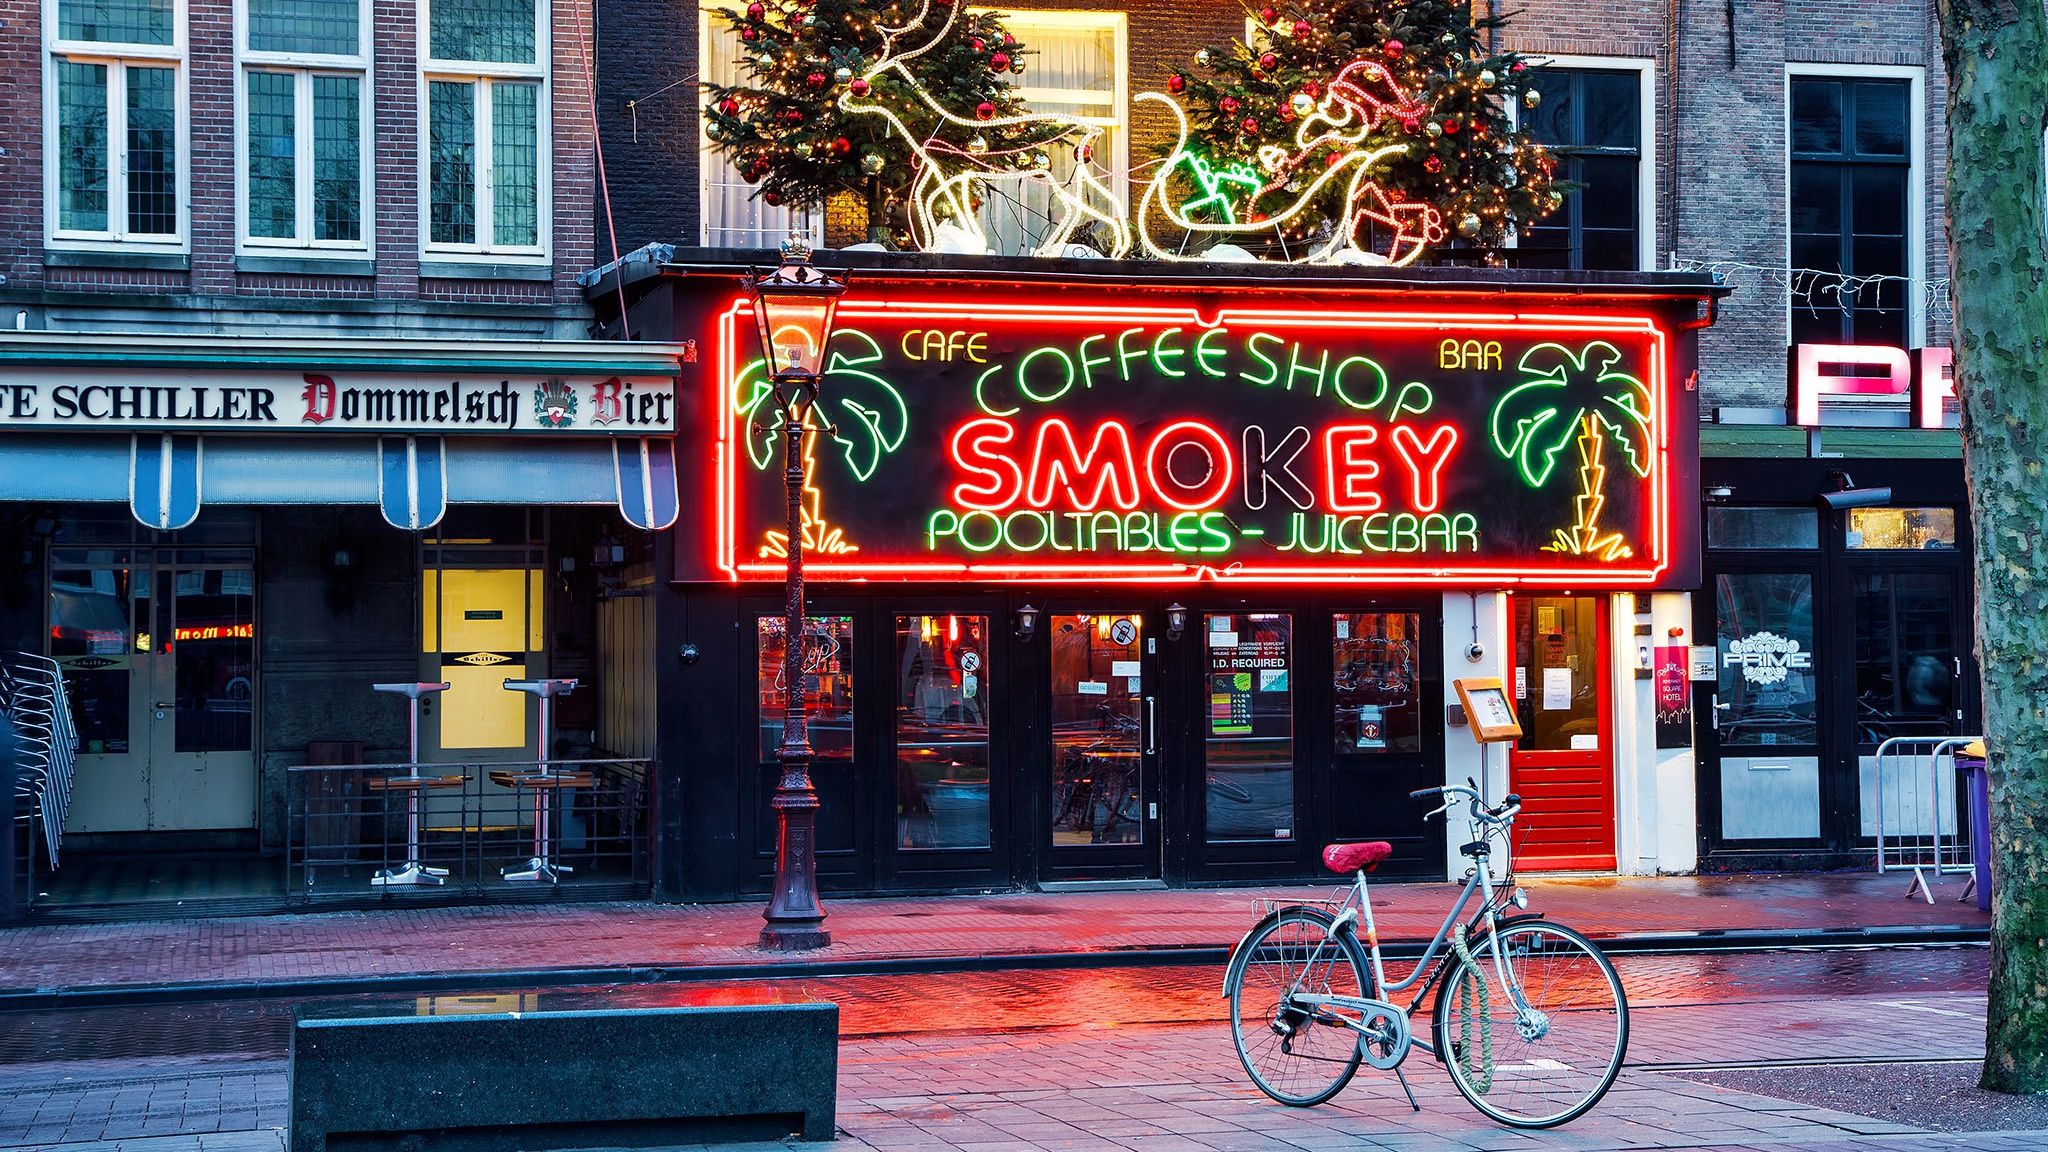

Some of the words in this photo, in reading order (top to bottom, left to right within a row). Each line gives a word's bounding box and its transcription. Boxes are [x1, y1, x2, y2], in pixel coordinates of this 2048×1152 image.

[902, 329, 988, 364] CAFE
[1439, 338, 1504, 371] BAR
[52, 385, 277, 421] SCHILLER
[301, 373, 519, 430] Dommelsch
[590, 376, 673, 427] Bier
[951, 418, 1458, 511] SMOKEY
[928, 509, 1231, 552] POOLTABLES
[1276, 511, 1479, 554] JUICEBAR
[1213, 659, 1229, 668] I.D.
[1231, 658, 1285, 668] REQUIRED
[1723, 652, 1812, 669] PRIME
[1663, 693, 1682, 701] HOTEL
